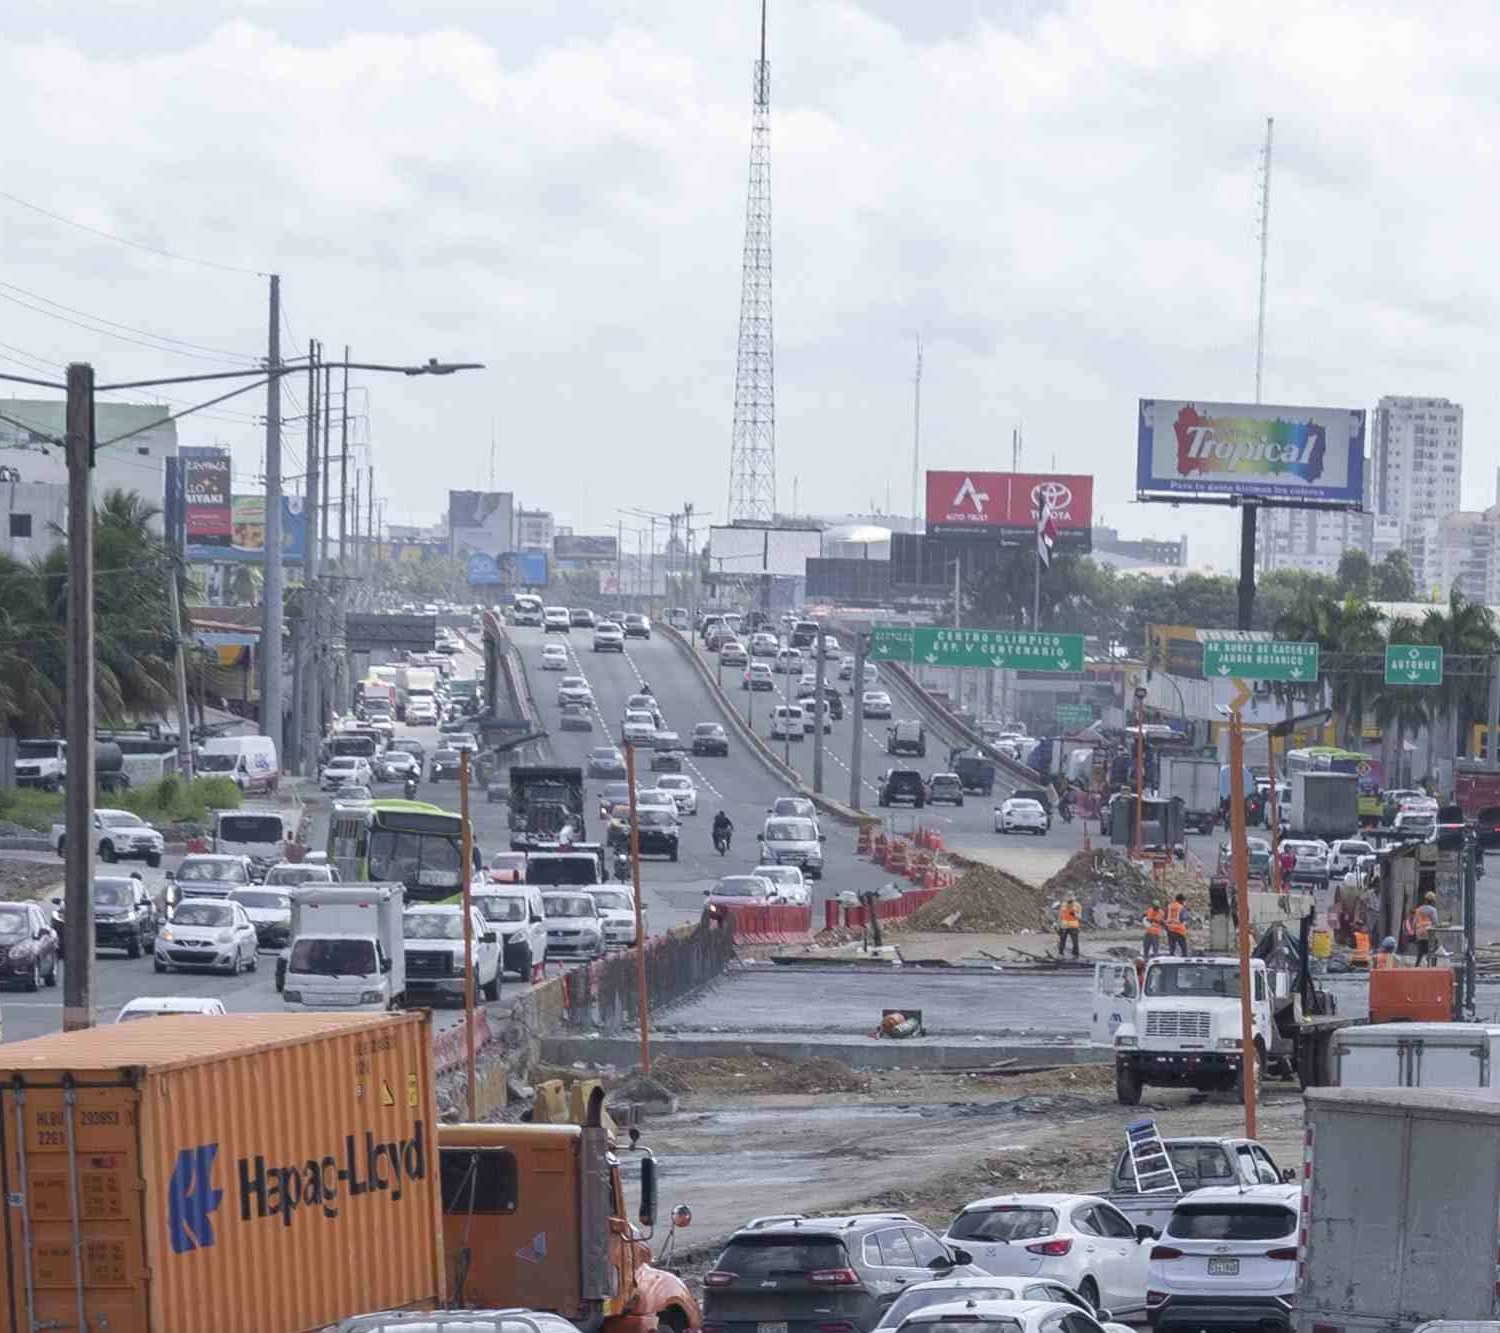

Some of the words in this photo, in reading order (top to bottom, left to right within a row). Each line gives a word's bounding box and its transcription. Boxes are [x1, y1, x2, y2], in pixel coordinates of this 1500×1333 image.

[1185, 427, 1318, 471] Tropical
[980, 645, 1064, 657] CENTENARIO
[238, 1119, 426, 1226] Hapag-Lloyd
